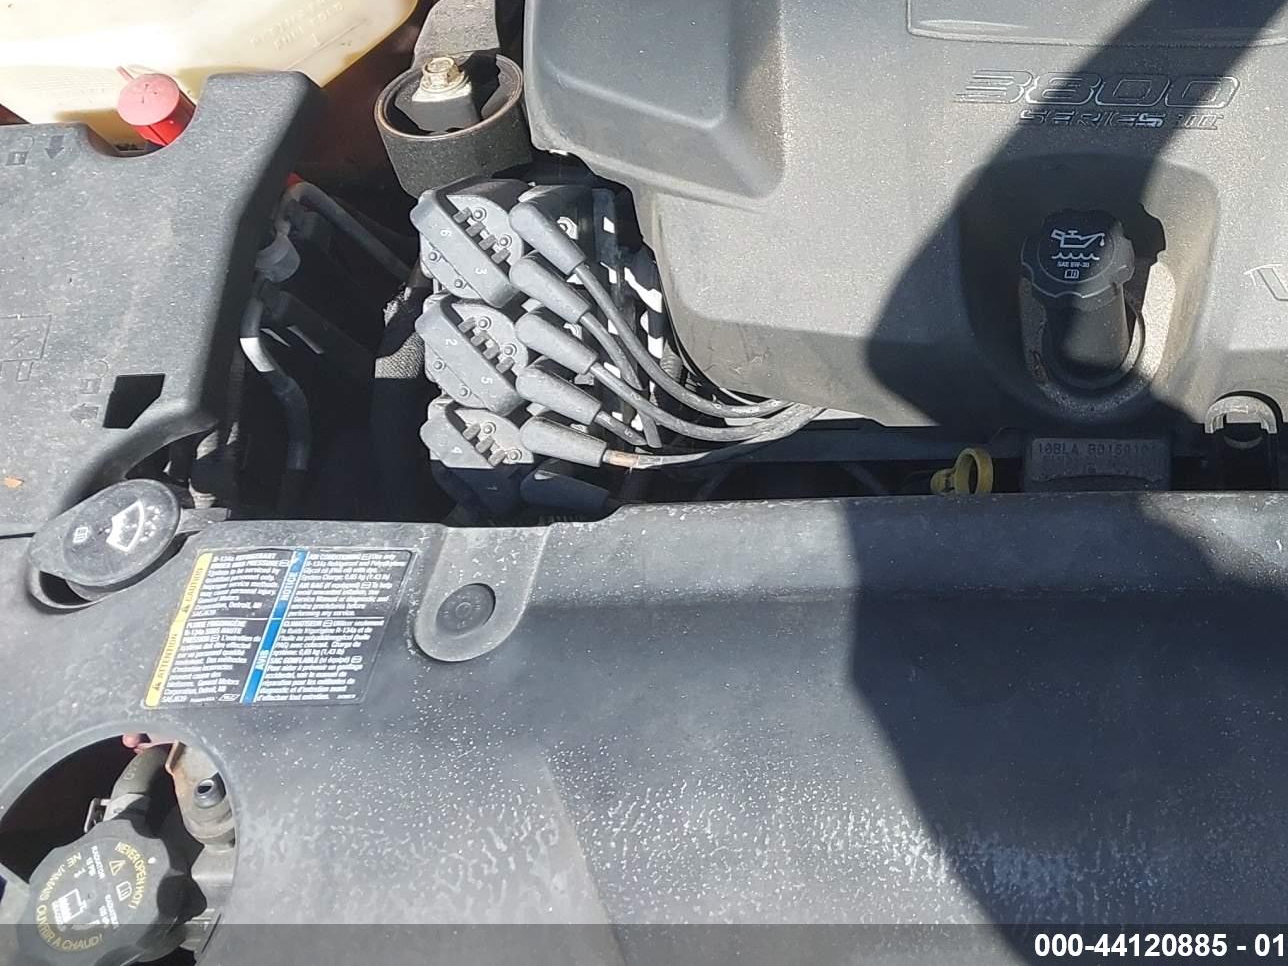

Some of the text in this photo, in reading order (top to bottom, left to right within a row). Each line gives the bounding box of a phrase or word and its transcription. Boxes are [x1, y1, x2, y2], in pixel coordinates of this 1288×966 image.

[953, 70, 1241, 108] 3800
[1018, 109, 1166, 129] SERIES
[66, 852, 82, 868] NE
[133, 859, 147, 883] OPEN
[40, 864, 66, 902] JAMAIS
